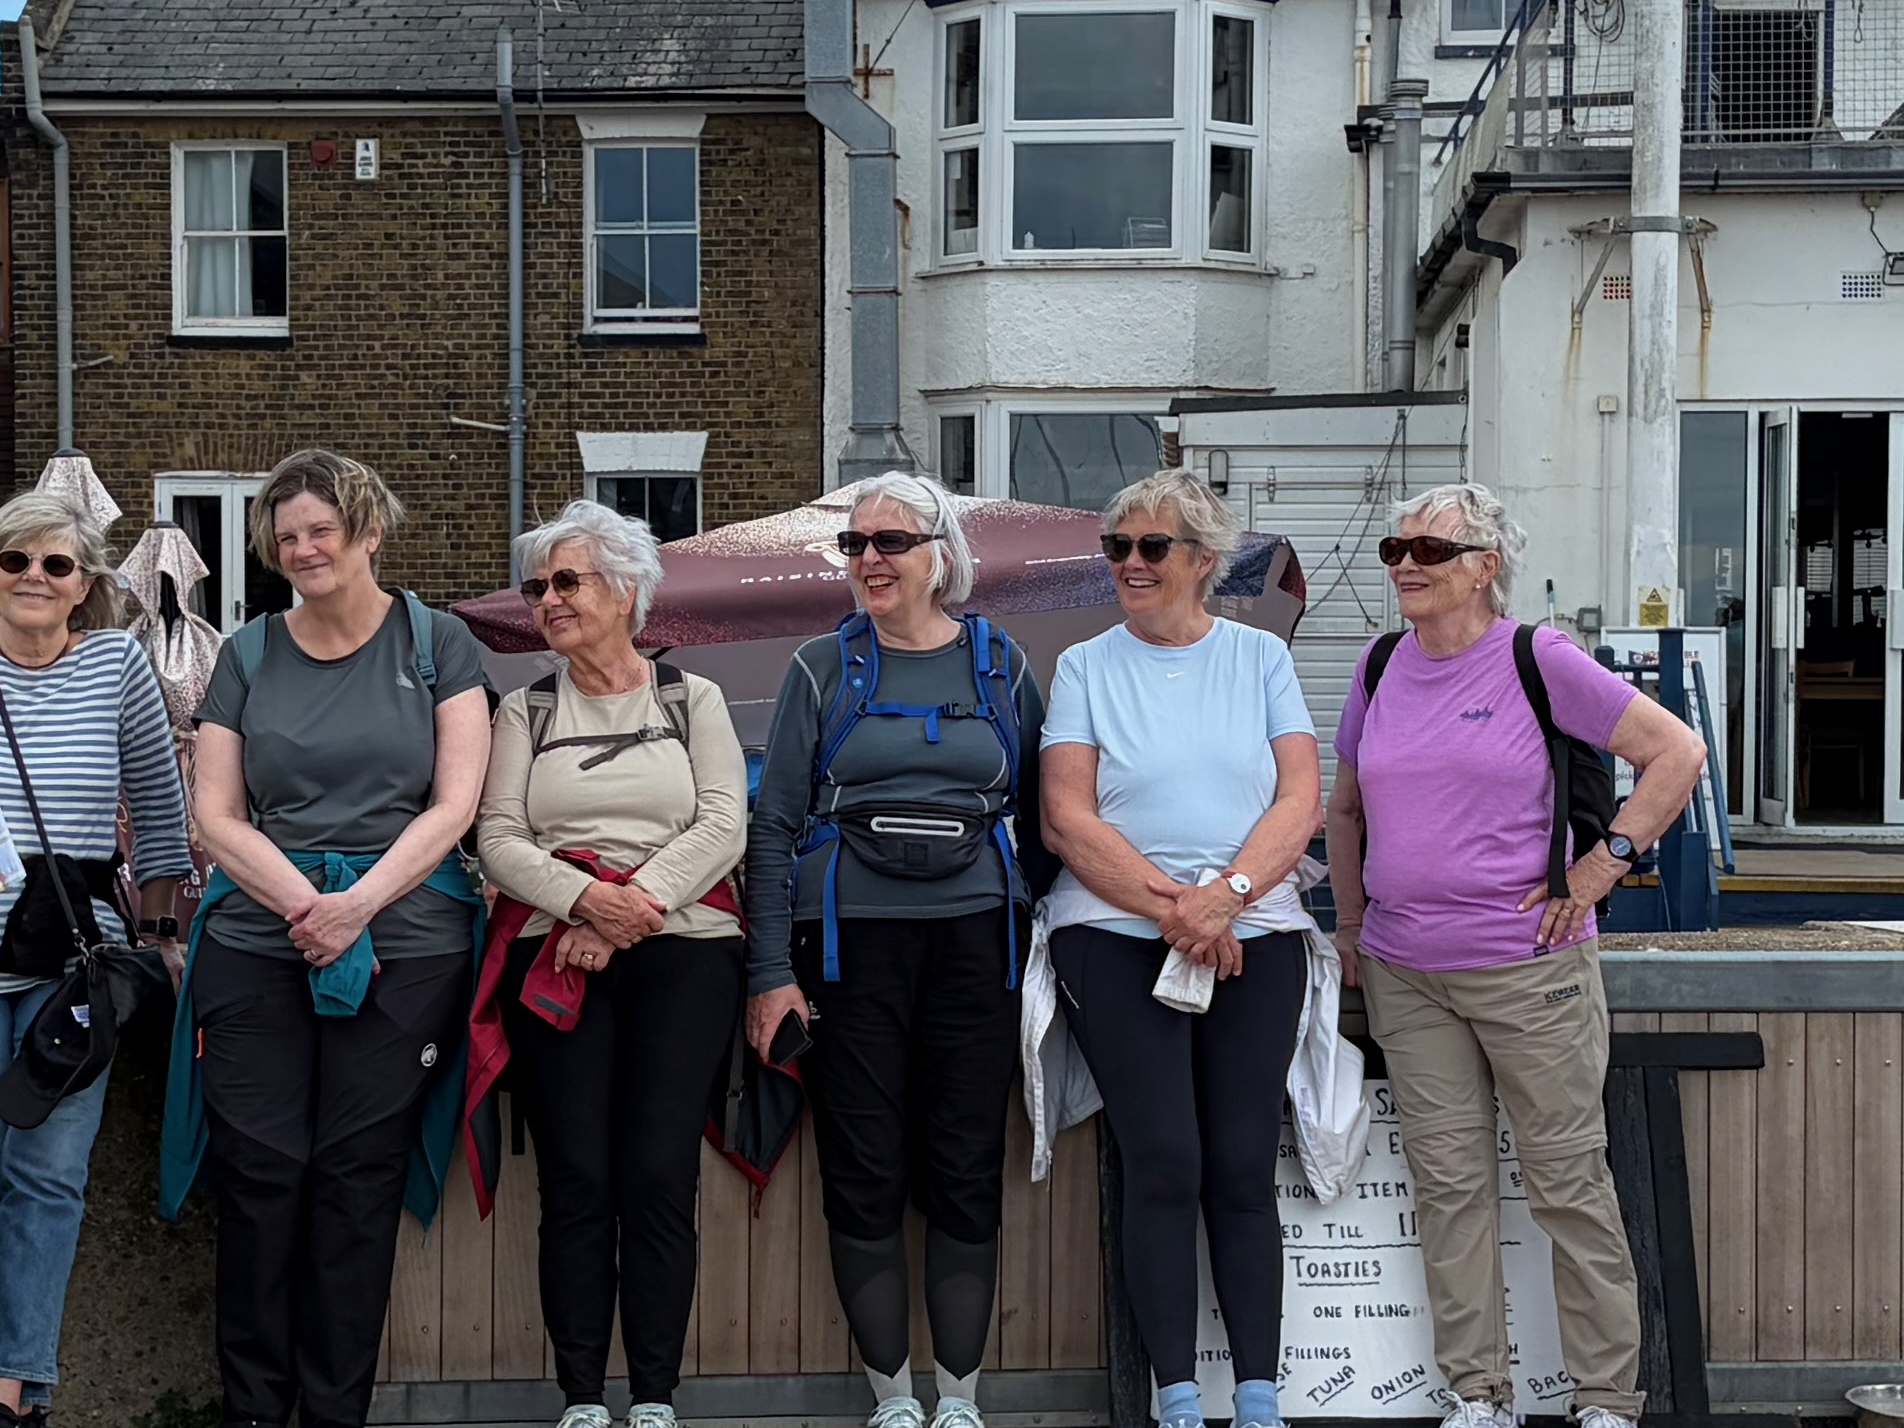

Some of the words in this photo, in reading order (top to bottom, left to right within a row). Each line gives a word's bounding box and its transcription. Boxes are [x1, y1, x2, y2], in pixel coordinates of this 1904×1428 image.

[1323, 1223, 1364, 1239] TILL
[1289, 1256, 1382, 1279] TOASTIES
[1313, 1305, 1342, 1318] ONE
[1284, 1345, 1352, 1360] FILLINGS
[1306, 1365, 1356, 1404] TUNA
[1371, 1363, 1426, 1400] ONION
[1528, 1370, 1570, 1395] BAC
